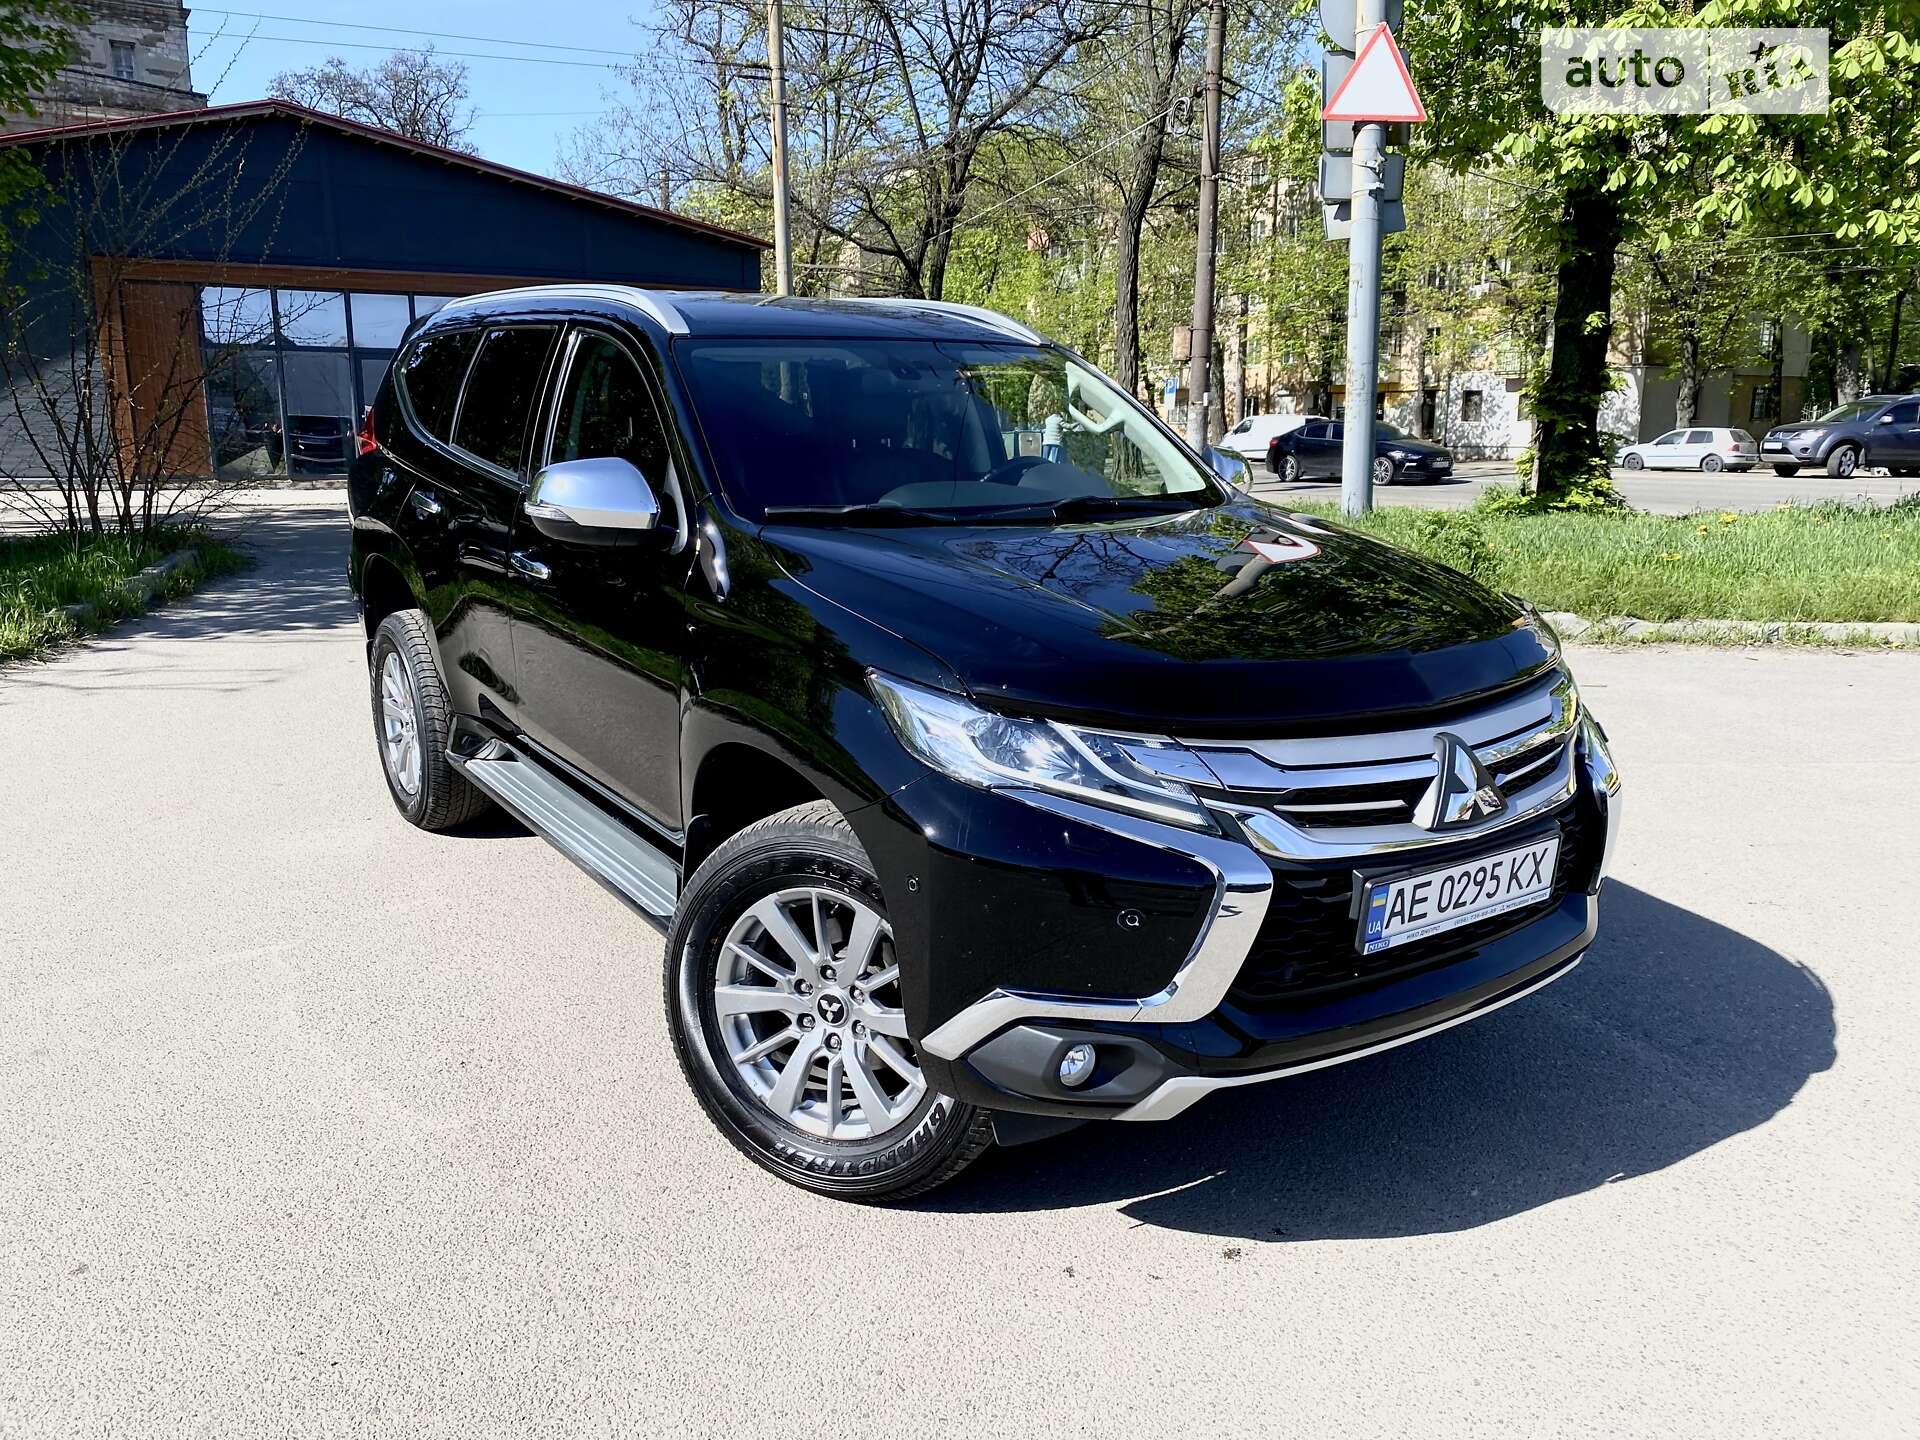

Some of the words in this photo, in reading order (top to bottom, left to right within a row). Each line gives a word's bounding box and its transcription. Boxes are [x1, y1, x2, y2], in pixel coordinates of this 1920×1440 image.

[1384, 880, 1432, 930] AE
[1437, 861, 1504, 914] 0295
[1506, 847, 1549, 895] KX
[1368, 920, 1382, 935] UA
[1368, 941, 1389, 952] NIKO
